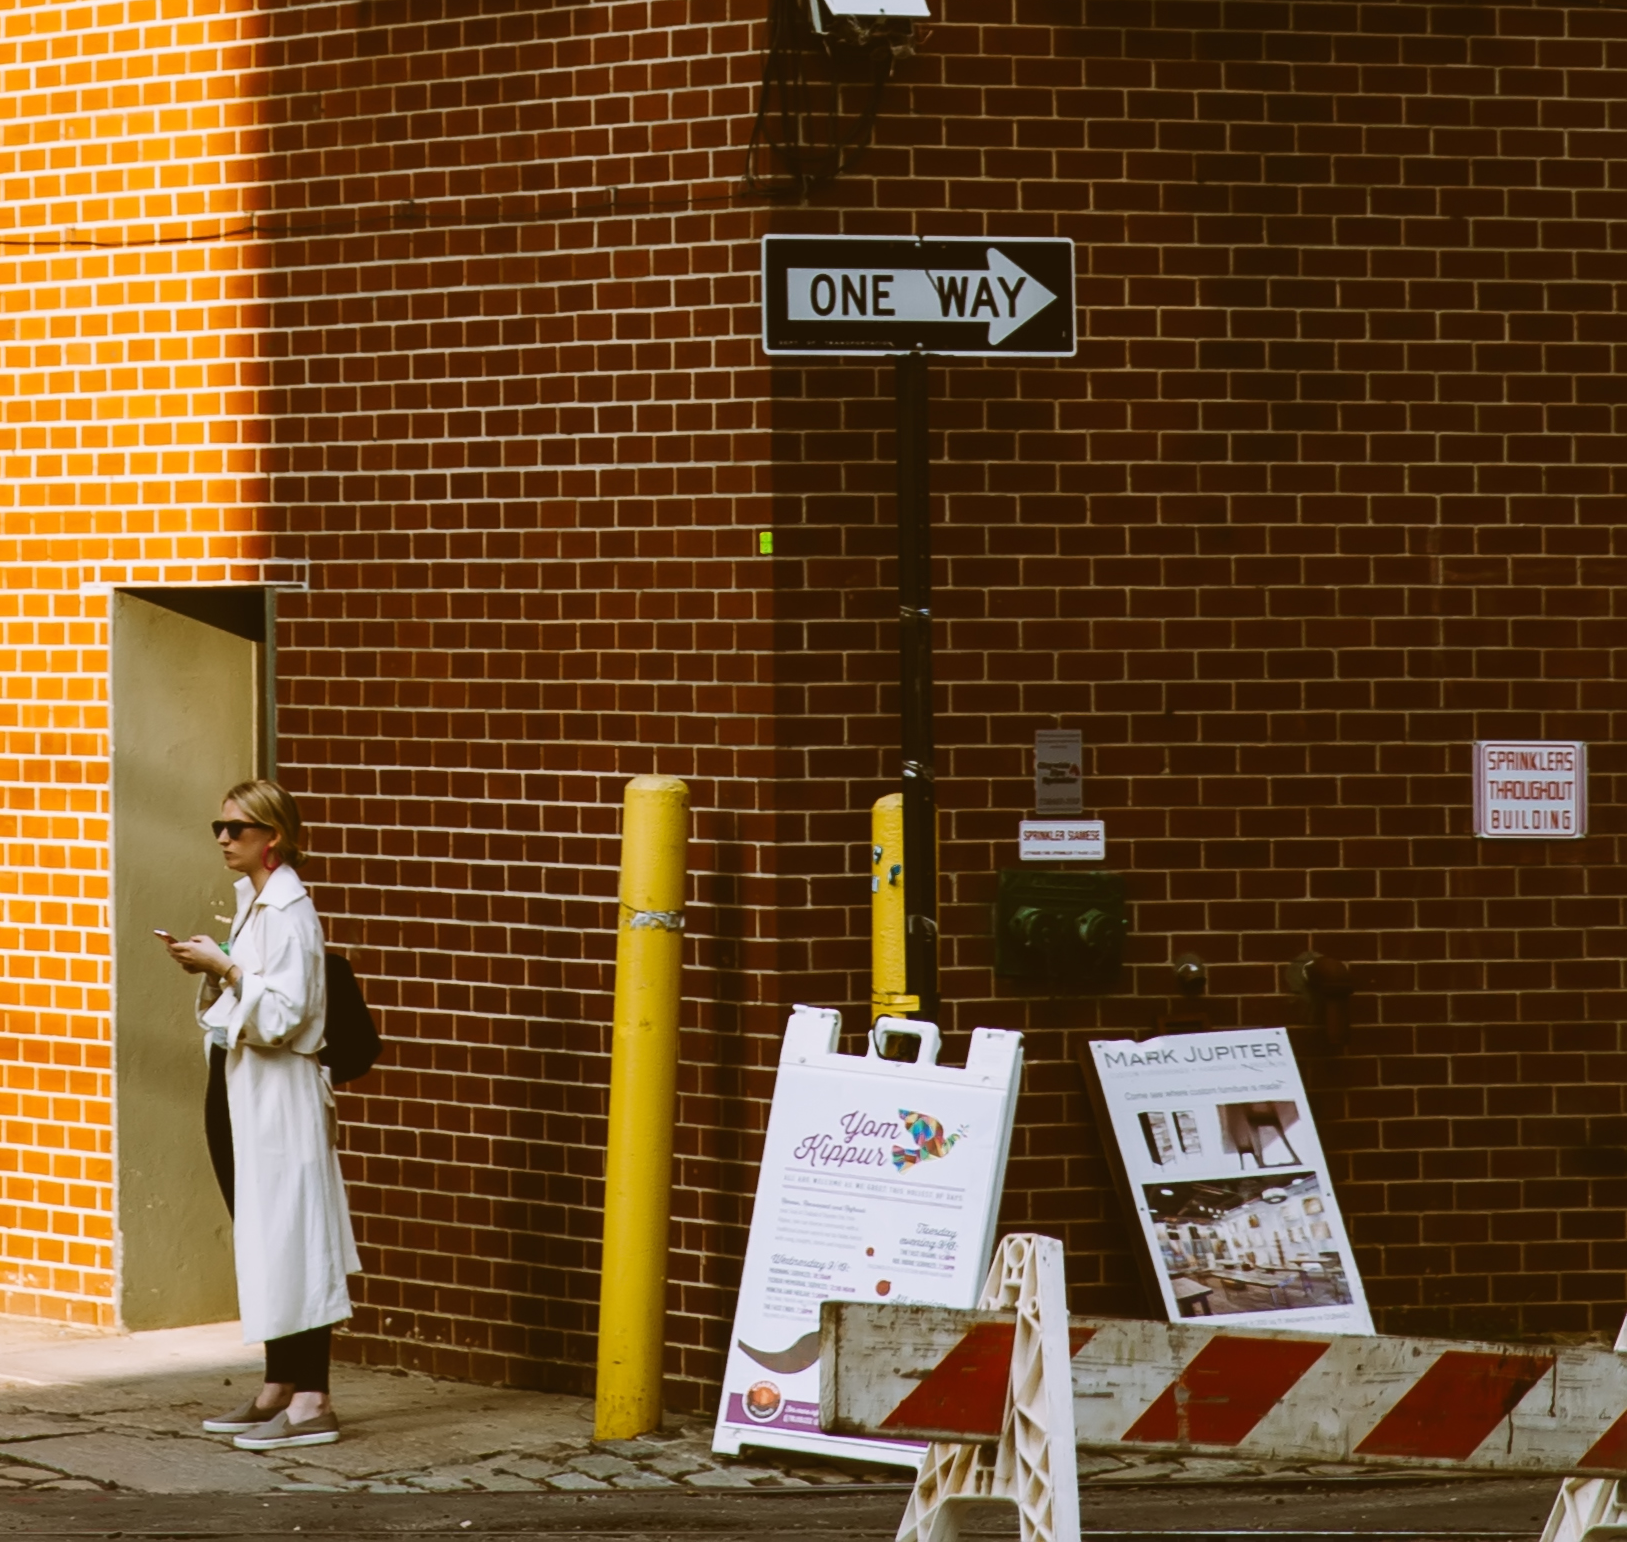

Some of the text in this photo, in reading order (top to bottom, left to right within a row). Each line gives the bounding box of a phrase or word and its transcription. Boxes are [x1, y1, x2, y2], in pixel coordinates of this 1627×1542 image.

[809, 273, 1028, 319] ONE WAY
[1487, 750, 1574, 771] SPRINKLERS
[1487, 780, 1574, 801] THROUGHOUT
[1490, 809, 1572, 830] BUILDING
[1103, 1042, 1283, 1069] MARK JUPITER
[839, 1109, 902, 1144] Yom
[792, 1133, 887, 1168] Kippur
[915, 1222, 958, 1240] Tuesday
[899, 1237, 937, 1251] evening
[770, 1253, 827, 1272] Wednesday
